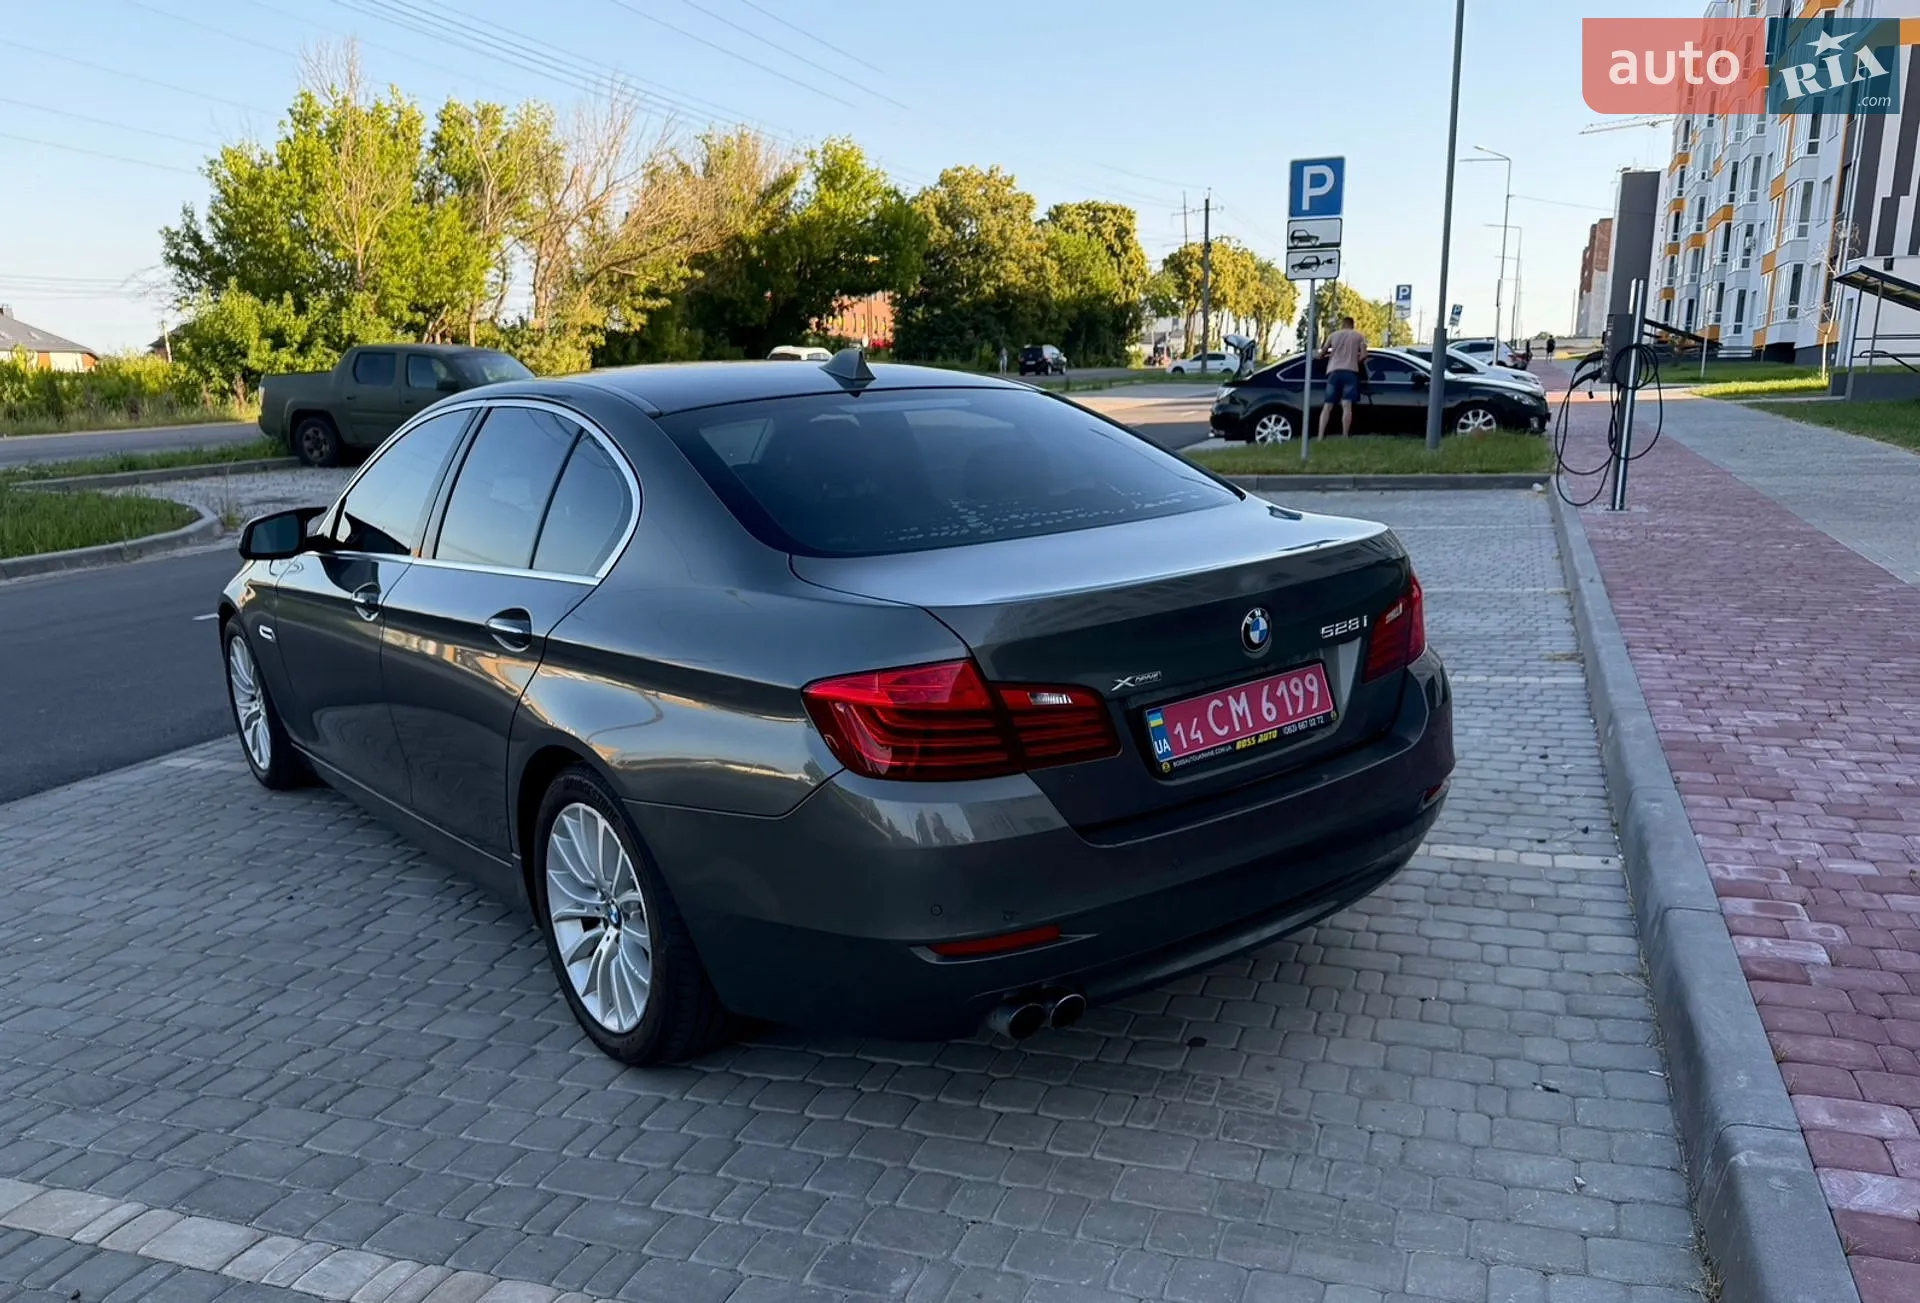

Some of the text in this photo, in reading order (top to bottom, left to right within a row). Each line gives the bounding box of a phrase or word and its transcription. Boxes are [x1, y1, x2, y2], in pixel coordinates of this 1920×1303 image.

[1302, 164, 1335, 211] P
[1399, 286, 1409, 299] P
[1173, 672, 1320, 750] 14 CM 6199
[1153, 737, 1172, 755] UA
[1236, 729, 1278, 751] BOSS AUTO
